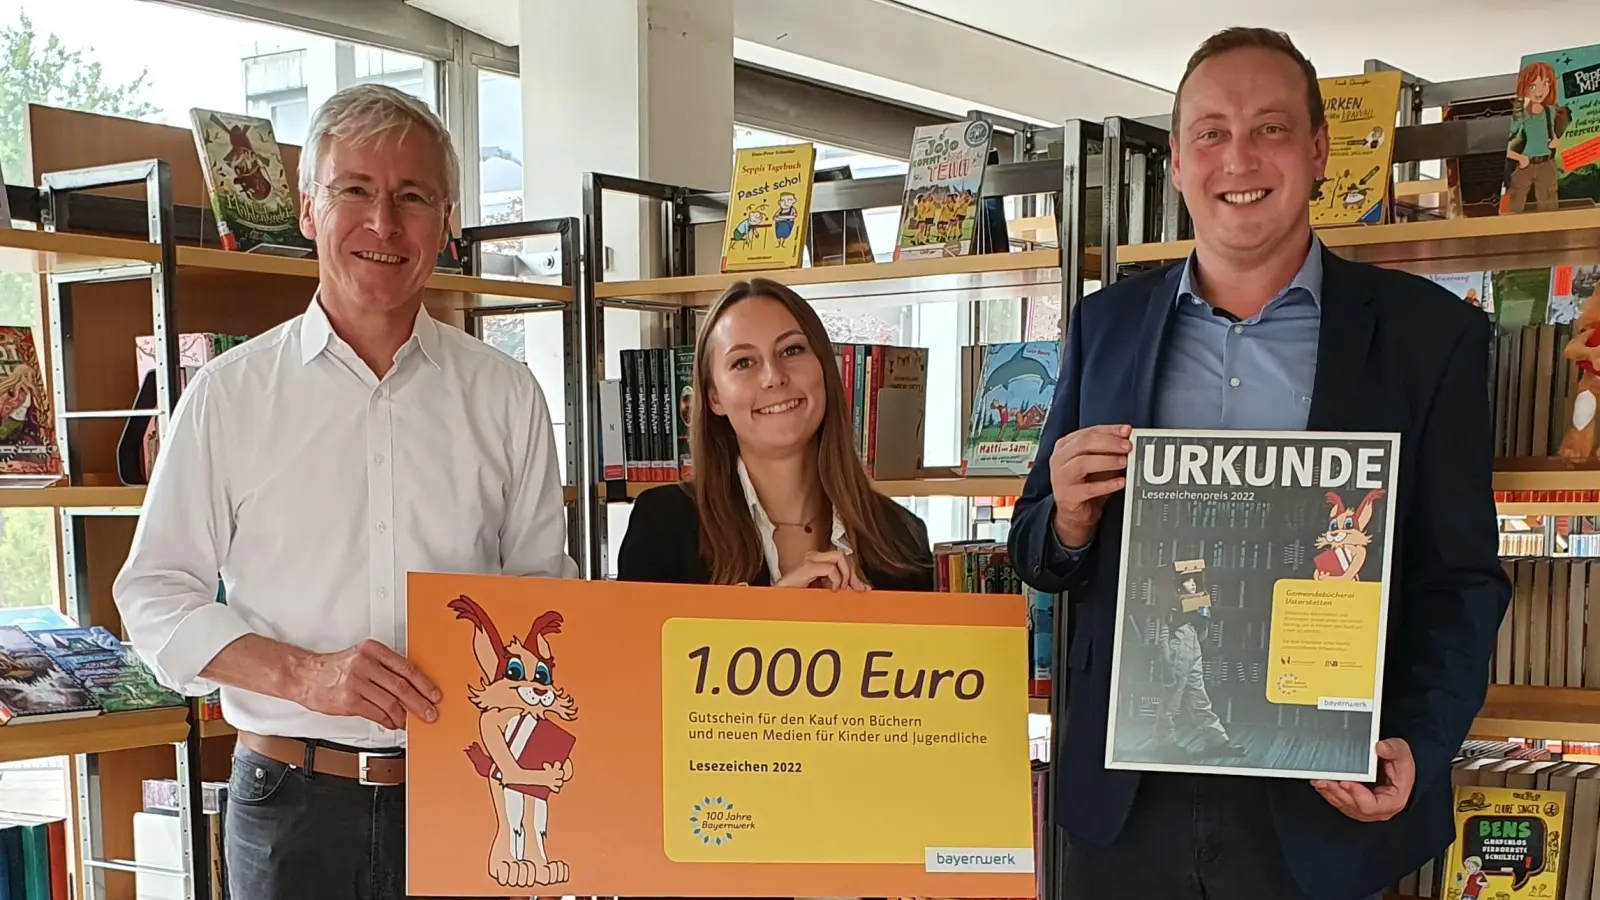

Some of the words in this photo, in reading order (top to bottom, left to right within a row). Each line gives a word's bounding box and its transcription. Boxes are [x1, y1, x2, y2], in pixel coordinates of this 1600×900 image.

[1323, 96, 1363, 111] URKEN
[742, 164, 765, 175] Seppis
[767, 161, 802, 173] Tagebuch
[737, 181, 770, 201] Passt
[1009, 442, 1030, 453] Sami
[1142, 444, 1385, 489] URKUNDE
[1142, 490, 1229, 501] Lesezeichenpreis
[1230, 492, 1255, 501] 2022
[688, 646, 841, 698] 1.000
[860, 650, 985, 700] Euro
[1324, 699, 1367, 708] bayernwerk
[688, 712, 754, 725] Gutschein
[758, 712, 777, 725] für
[780, 712, 804, 725] den
[809, 714, 839, 726] Kauf
[842, 716, 865, 727] von
[869, 715, 922, 727] Büchern
[688, 729, 713, 740] und
[718, 731, 758, 741] neuen
[763, 729, 811, 741] Medien
[815, 730, 834, 742] für
[838, 731, 880, 743] Kinder
[884, 731, 908, 743] und
[912, 731, 987, 746] Jugendliche
[689, 760, 768, 772] Lesezeichen
[772, 762, 802, 773] 2022
[706, 811, 724, 821] 100
[725, 811, 752, 821] Jahre
[702, 820, 756, 831] Bayernwerk
[1479, 820, 1532, 838] BENS
[936, 851, 1016, 867] bayernwerk
